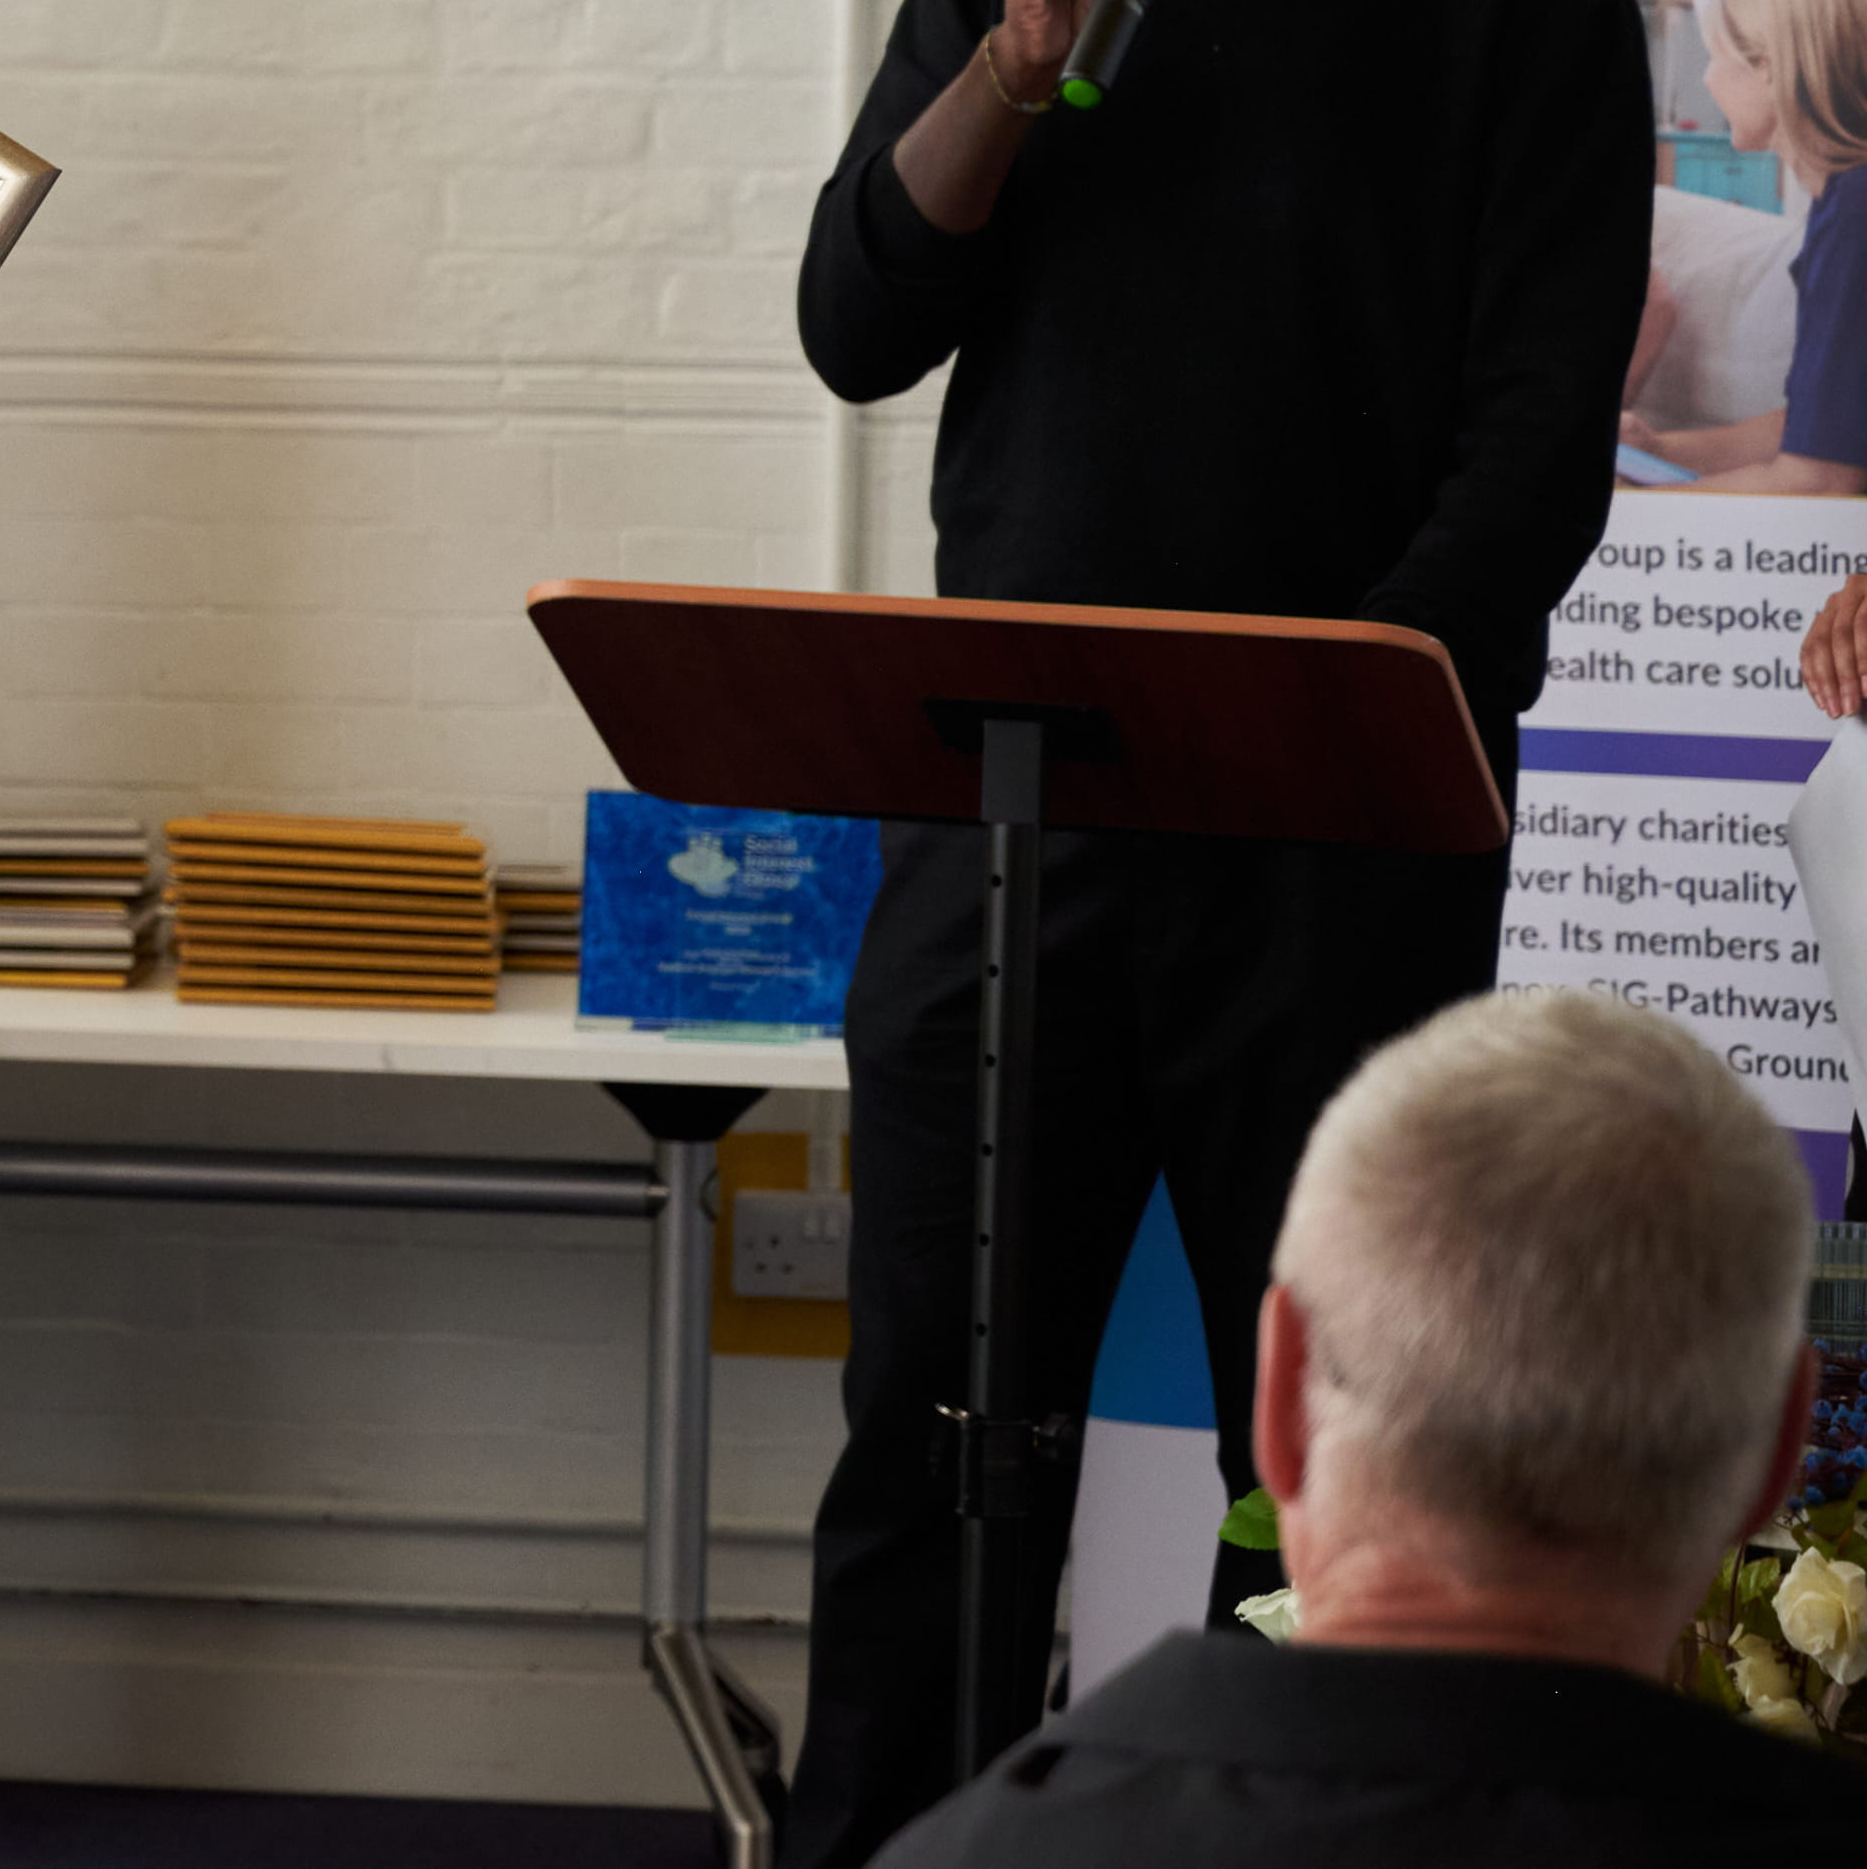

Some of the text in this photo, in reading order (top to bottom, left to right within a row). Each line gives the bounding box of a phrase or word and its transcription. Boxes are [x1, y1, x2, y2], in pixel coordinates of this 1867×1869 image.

[1677, 537, 1703, 571] is
[1714, 546, 1733, 572] a
[1653, 594, 1803, 636] bespoke
[1646, 660, 1721, 687] care
[1638, 808, 1789, 848] charities
[1583, 863, 1797, 911] high-quality
[1560, 921, 1603, 953] Its
[1614, 926, 1780, 965] members
